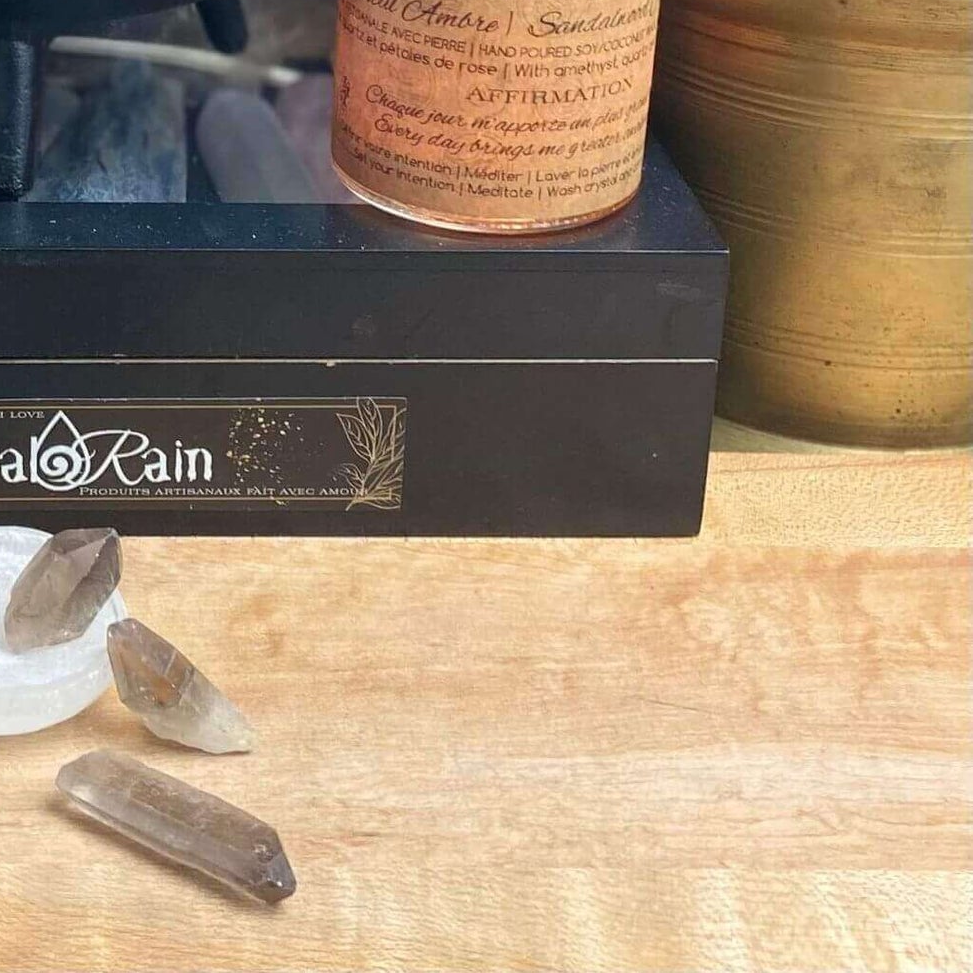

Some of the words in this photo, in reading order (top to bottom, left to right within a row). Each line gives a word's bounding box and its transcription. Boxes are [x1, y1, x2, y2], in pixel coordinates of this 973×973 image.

[402, 0, 500, 33] Ambre
[391, 25, 423, 44] AVEC
[424, 34, 467, 53] PIERRE
[479, 45, 517, 58] HAND
[520, 46, 572, 59] POURED
[434, 56, 454, 70] de
[459, 61, 497, 76] rose
[515, 64, 550, 78] With
[465, 75, 635, 105] AFFIRMATION
[366, 85, 424, 120] Chaque
[423, 109, 467, 126] jour
[375, 113, 424, 146] Every
[428, 134, 467, 154] day
[467, 136, 534, 161] brings
[537, 143, 569, 157] me
[395, 153, 452, 176] intention
[536, 170, 576, 182] Laver
[578, 167, 589, 179] la
[467, 182, 533, 198] Meditate
[547, 182, 582, 197] Wash
[10, 410, 45, 419] LOVE
[80, 428, 214, 488] Rain
[79, 485, 151, 496] PRODUITS
[247, 486, 276, 496] FAIT
[280, 487, 315, 496] AVEC
